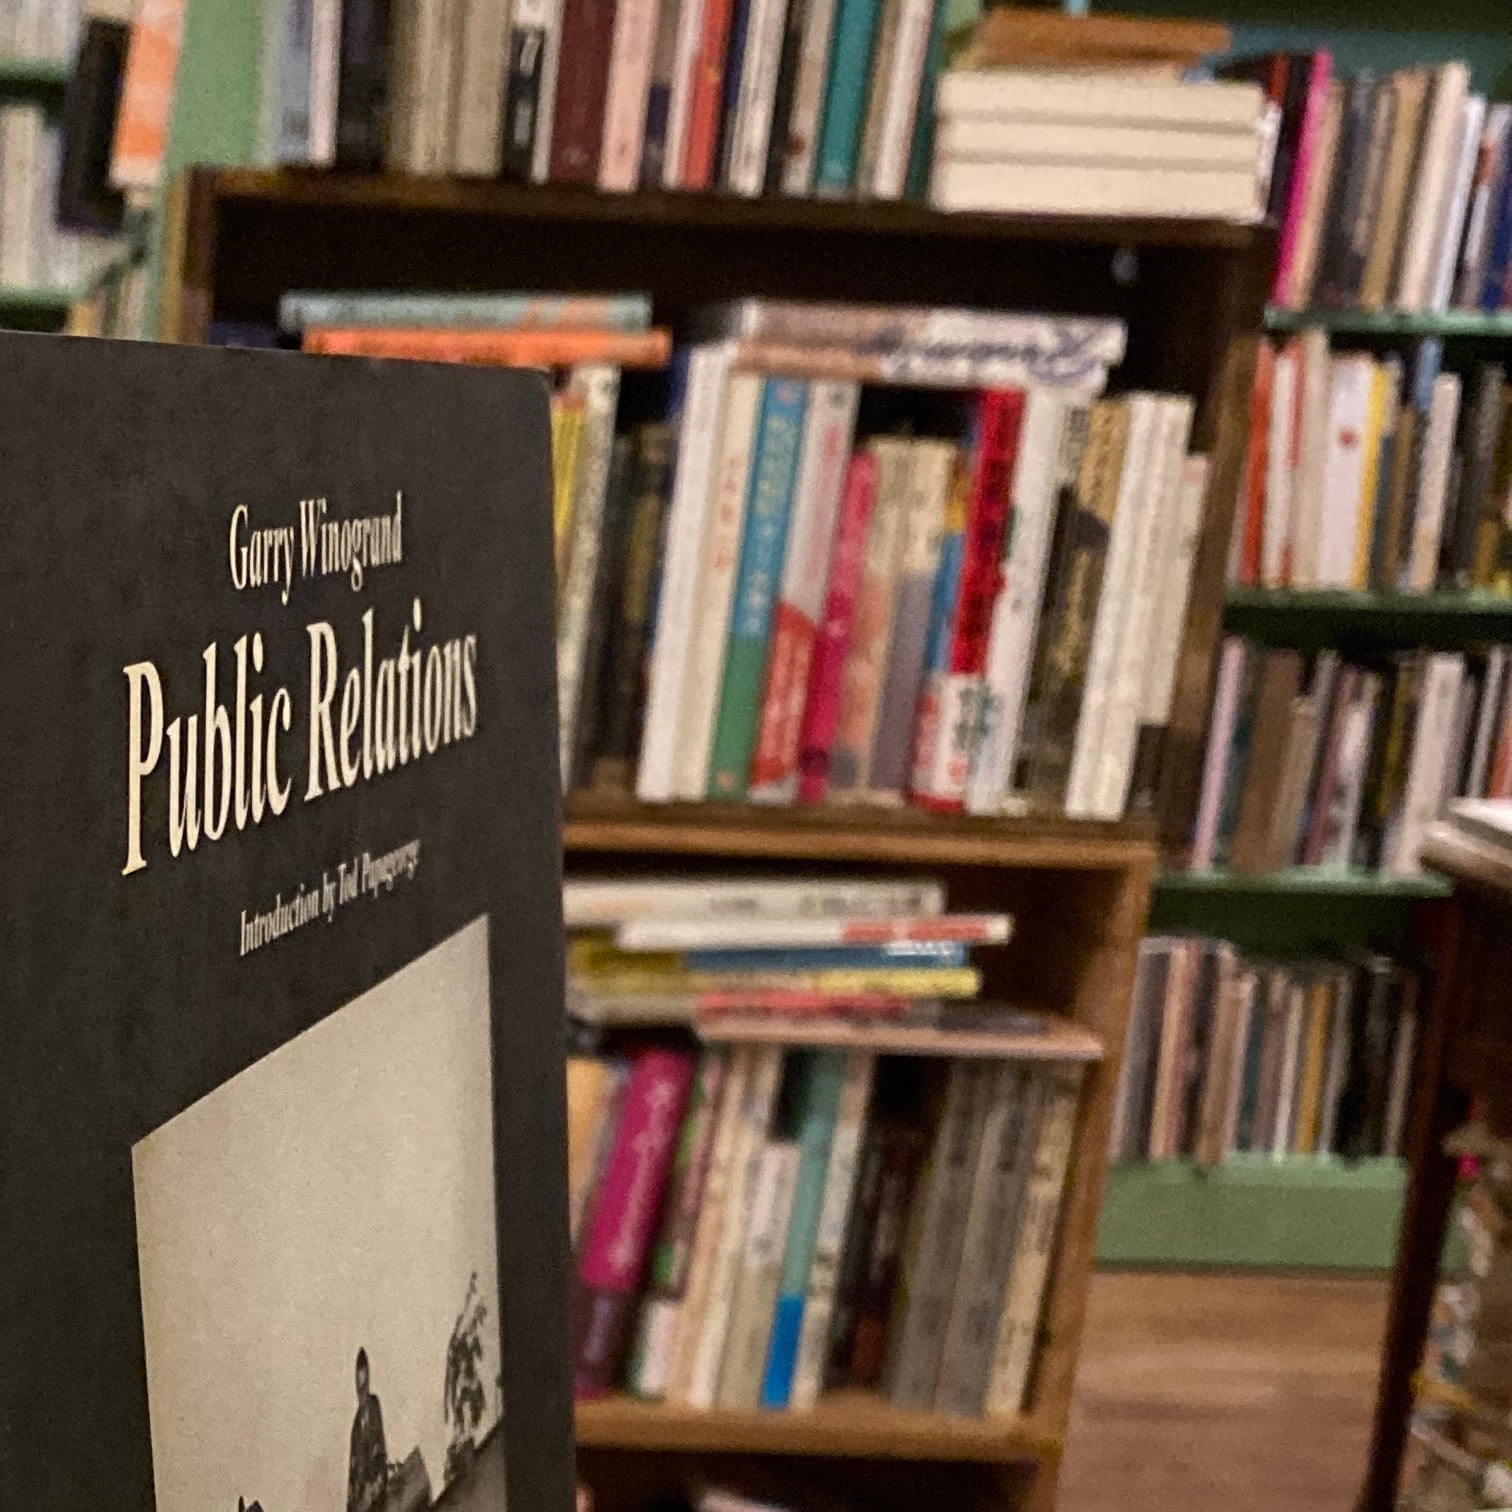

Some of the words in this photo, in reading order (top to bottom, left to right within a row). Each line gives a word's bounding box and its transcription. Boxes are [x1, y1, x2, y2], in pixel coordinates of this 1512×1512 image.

[229, 504, 294, 605] Garry
[299, 489, 402, 592] Winogrand
[122, 630, 292, 876] Public
[304, 597, 478, 802] Relations
[240, 882, 319, 957] Introduction
[322, 872, 336, 922] by
